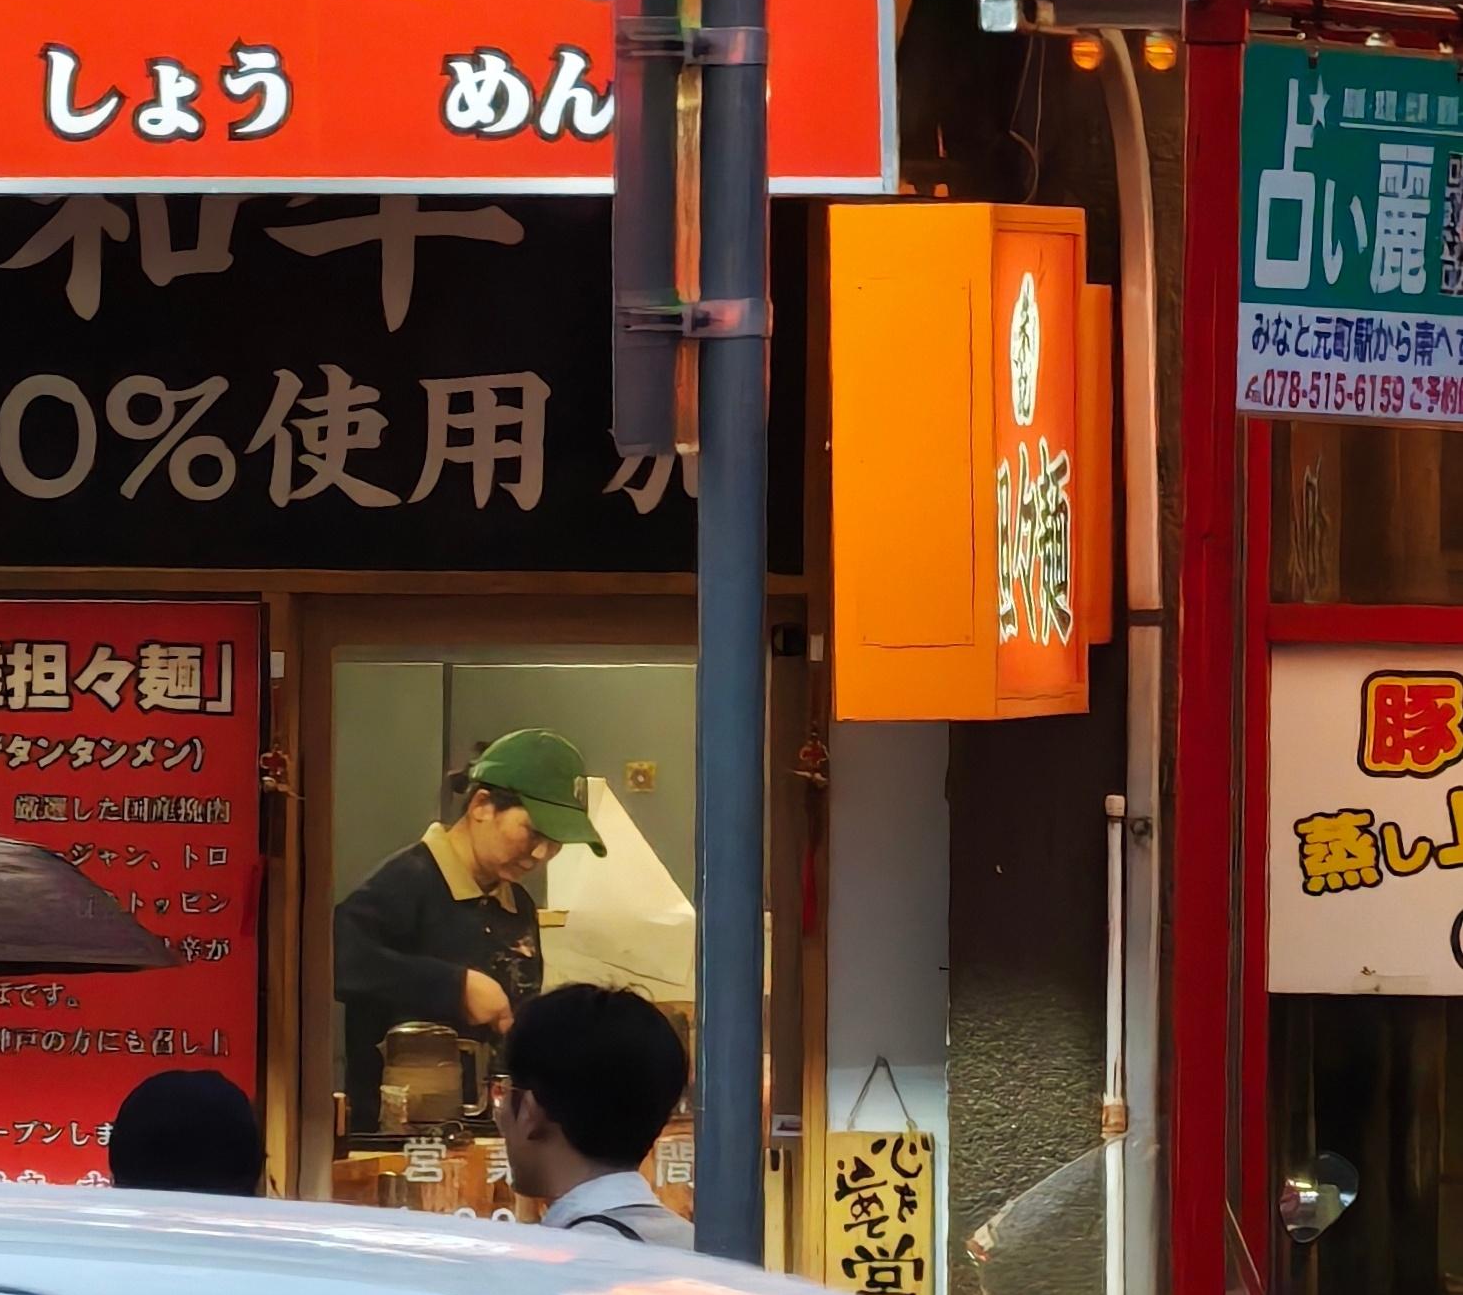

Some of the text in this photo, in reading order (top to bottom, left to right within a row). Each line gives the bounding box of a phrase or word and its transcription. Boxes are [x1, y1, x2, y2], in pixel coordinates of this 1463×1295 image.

[39, 36, 292, 142] しょう
[437, 44, 615, 142] めん
[1252, 311, 1463, 366] みなと元町駅から南へ
